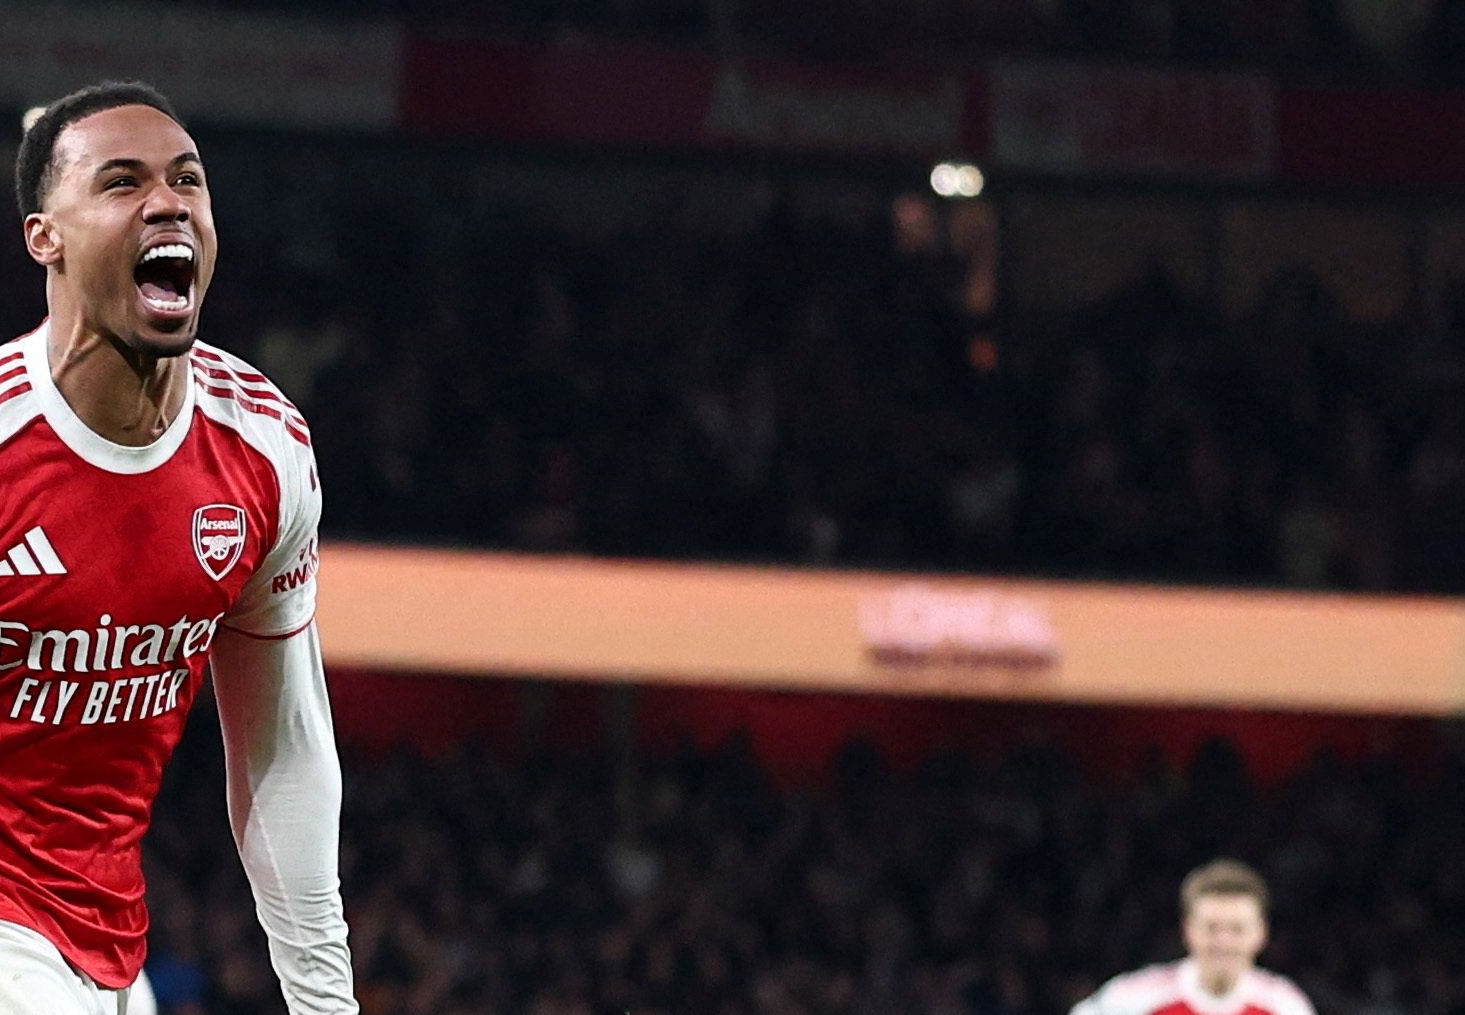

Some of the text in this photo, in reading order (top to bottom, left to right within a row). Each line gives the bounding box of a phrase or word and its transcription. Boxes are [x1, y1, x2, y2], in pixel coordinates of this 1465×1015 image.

[200, 517, 238, 530] Arsenal
[9, 668, 190, 725] FLY BETTER
